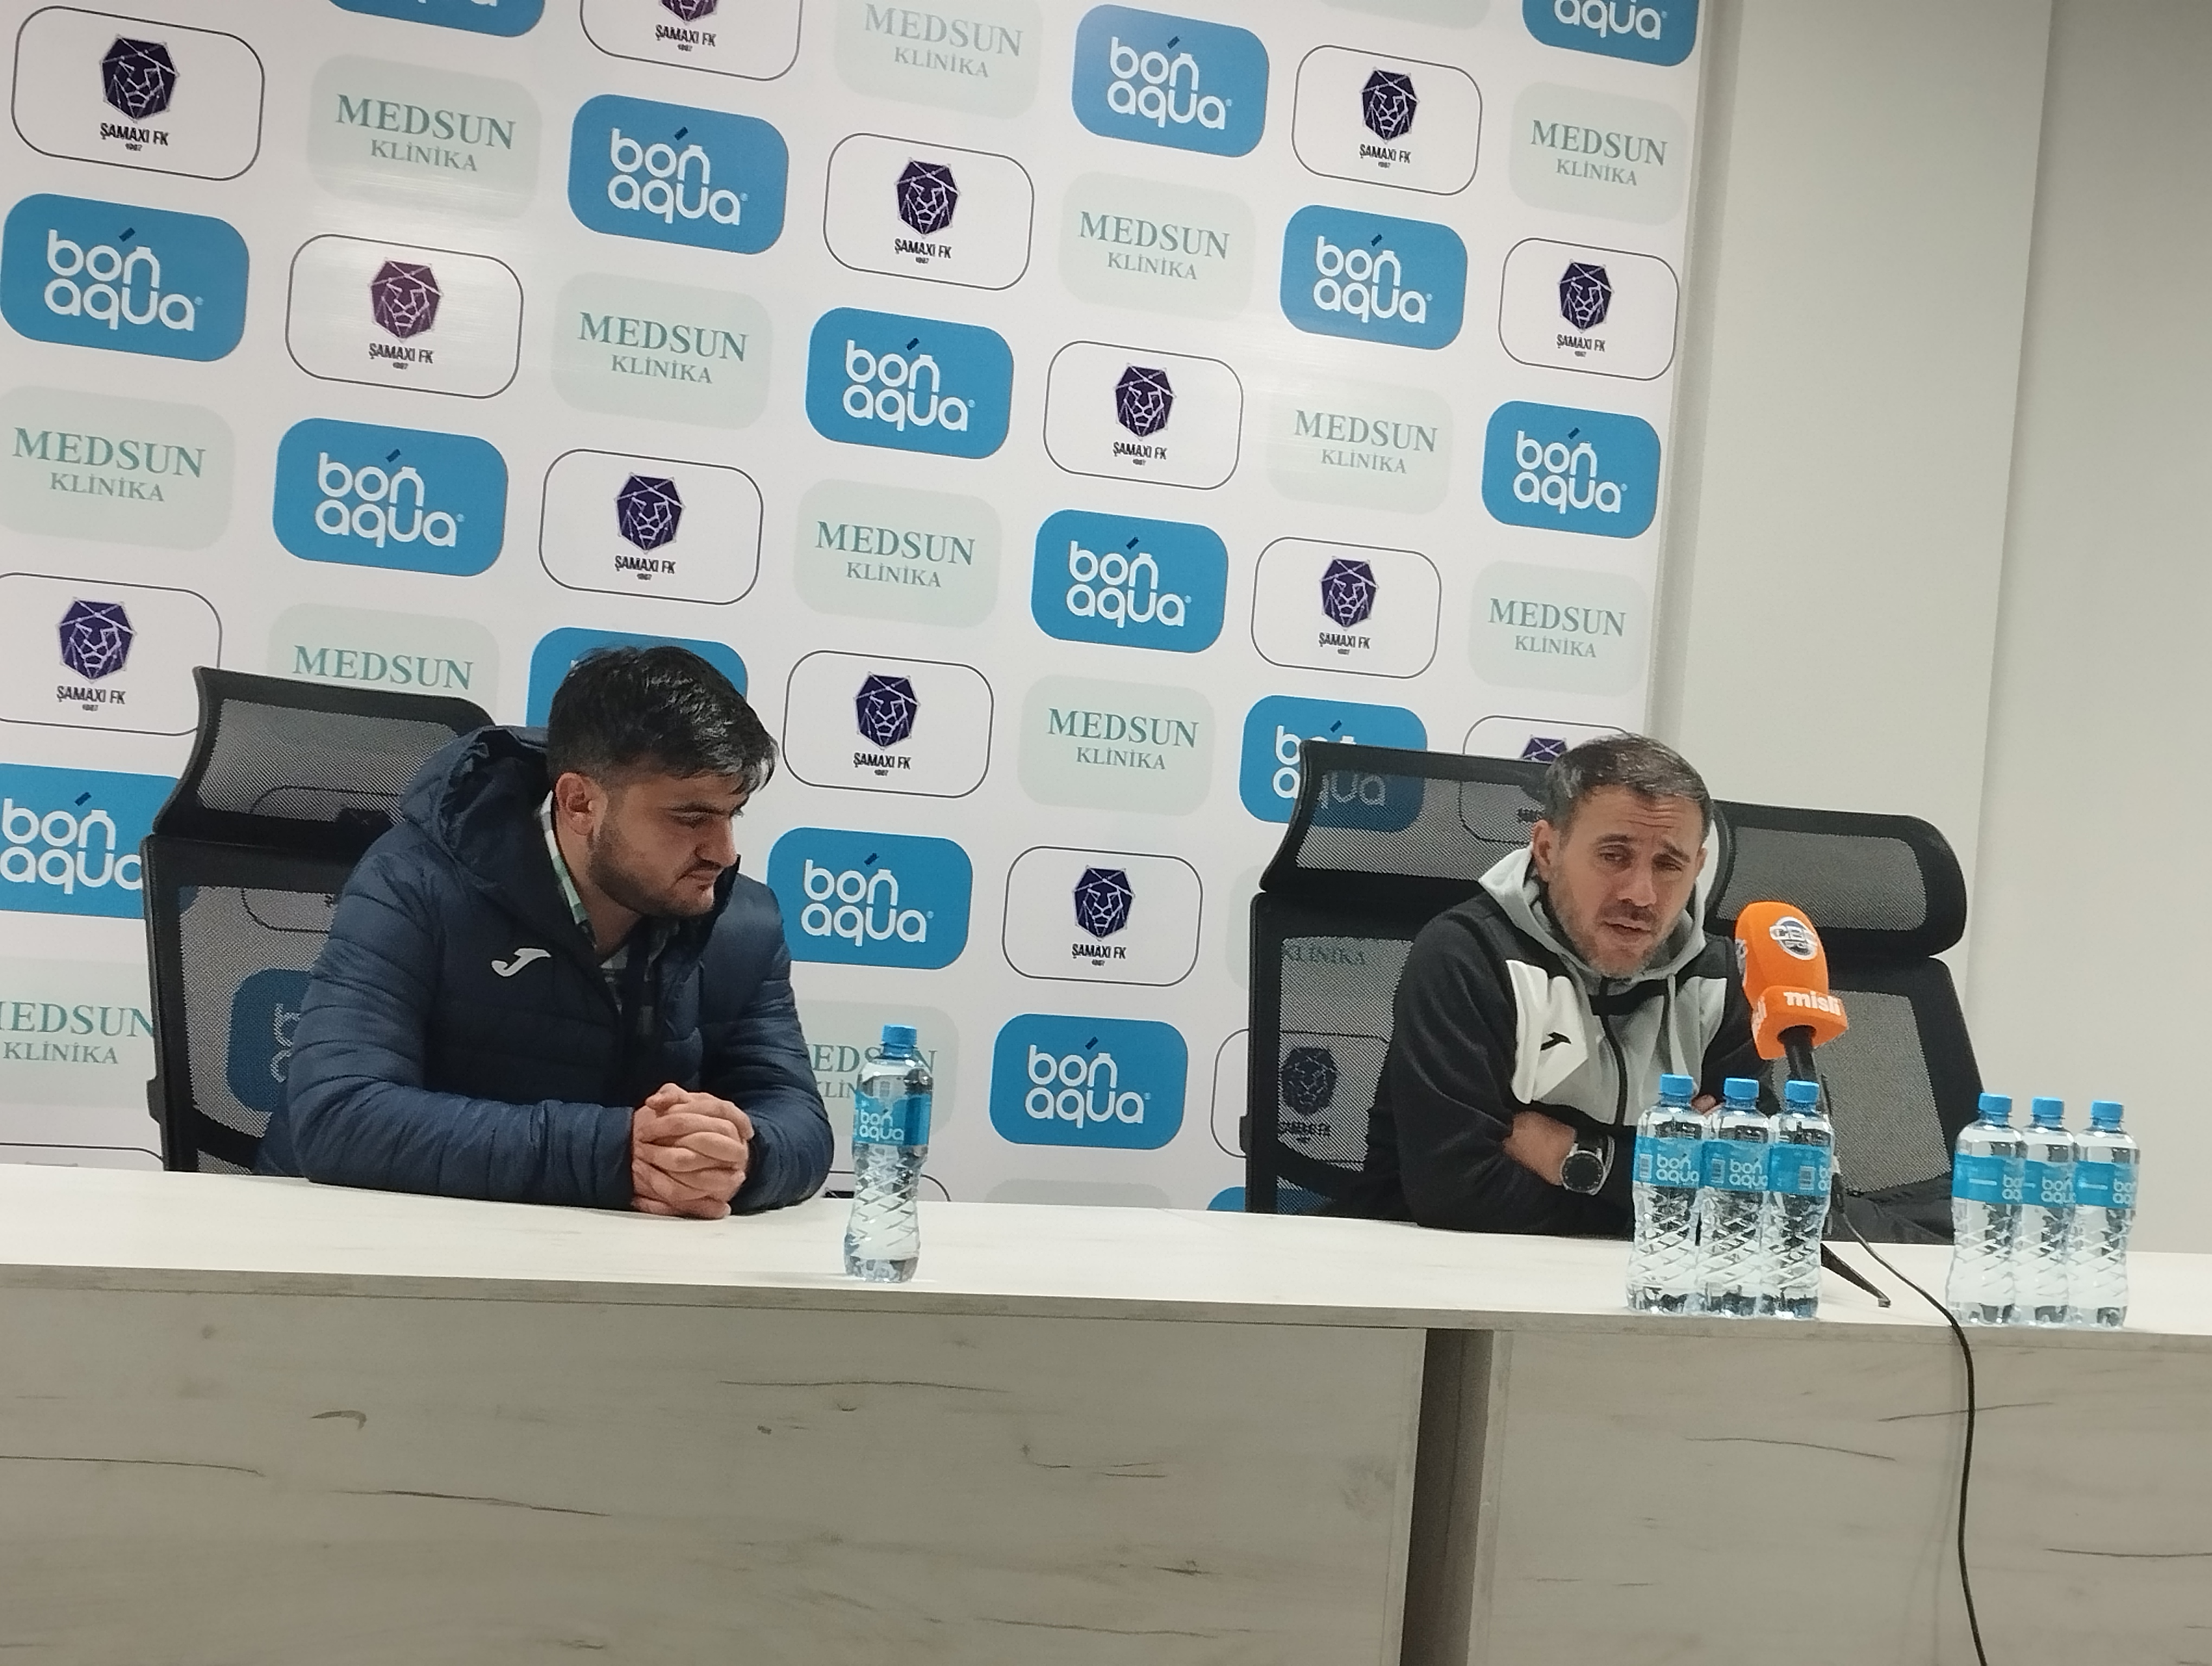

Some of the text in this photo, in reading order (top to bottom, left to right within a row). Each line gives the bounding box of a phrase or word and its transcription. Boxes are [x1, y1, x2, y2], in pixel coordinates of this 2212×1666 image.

[655, 24, 716, 47] ŞAMAXI FK
[866, 3, 1023, 56] MEDSUN
[1554, 0, 1661, 41] aqua
[895, 47, 988, 78] KLİNİKA
[1107, 80, 1226, 130] aqua
[100, 123, 169, 146] ŞAMAXI FK
[336, 94, 516, 150] MEDSUN
[371, 139, 477, 171] KLİNİKA
[1360, 144, 1411, 164] ŞAMAXI FK
[1531, 120, 1668, 166] MEDSUN
[1557, 158, 1637, 186] KLİNİKA
[608, 174, 741, 226] aqua
[895, 238, 951, 259] ŞAMAXI FK
[1080, 212, 1230, 259] MEDSUN
[1108, 252, 1197, 280] KLİNİKA
[44, 278, 195, 331] aqua
[1313, 278, 1426, 324] aqua
[577, 312, 749, 362] MEDSUN
[1557, 334, 1605, 352] ŞAMAXI FK
[369, 343, 434, 363] ŞAMAXI FK
[612, 355, 712, 384] KLİNİKA
[843, 385, 968, 432] aqua
[1294, 410, 1438, 452] MEDSUN
[12, 427, 206, 478] MEDSUN
[1113, 441, 1167, 460] ŞAMAXI FK
[1321, 449, 1406, 474] KLİNİKA
[50, 472, 164, 502] KLİNİKA
[1513, 471, 1621, 514] aqua
[315, 499, 457, 548] aqua
[815, 521, 975, 565] MEDSUN
[615, 555, 676, 574] ŞAMAXI FK
[846, 562, 941, 587] KLİNİKA
[1066, 584, 1185, 628] aqua
[1488, 598, 1626, 637] MEDSUN
[1319, 632, 1371, 649] ŞAMAXI FK
[1515, 636, 1596, 658] KLİNİKA
[292, 645, 473, 690] MEDSUN
[56, 685, 126, 704] ŞAMAXI FK
[1047, 708, 1199, 748] MEDSUN
[853, 752, 911, 770] ŞAMAXI FK
[1077, 747, 1165, 770] KLİNİKA
[801, 902, 927, 947] aqua
[1072, 944, 1126, 959] ŞAMAXI FK
[1783, 990, 1842, 1016] misli
[0, 1001, 152, 1037] EDSUN
[3, 1041, 118, 1065] KLİNİKA
[1025, 1087, 1144, 1129] aqua
[859, 1124, 904, 1142] aqua
